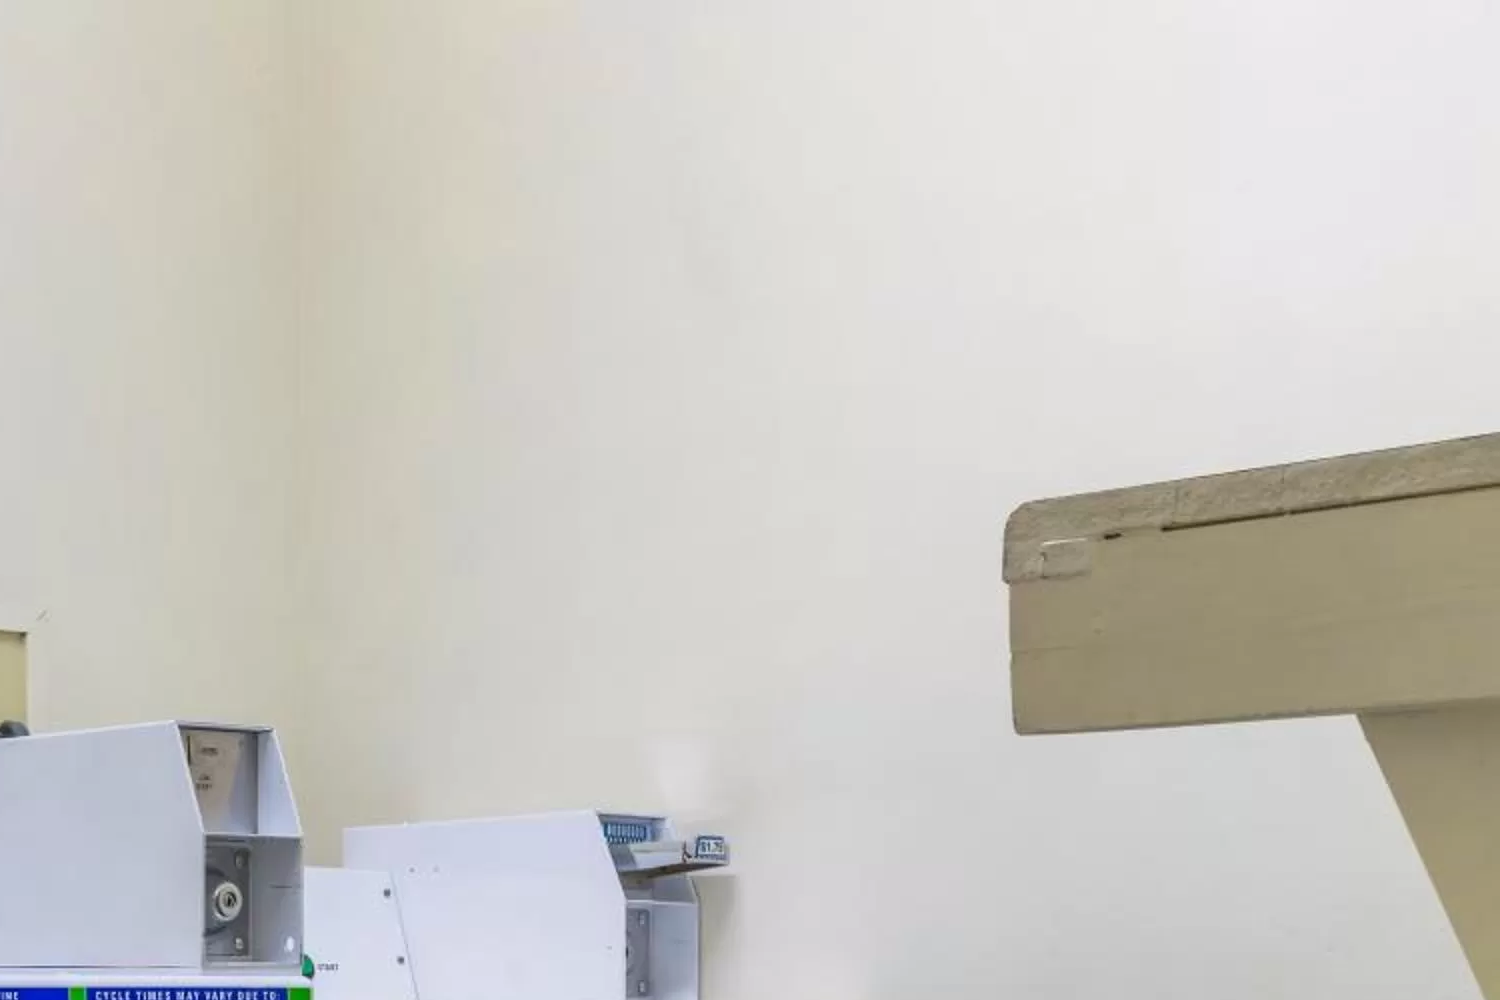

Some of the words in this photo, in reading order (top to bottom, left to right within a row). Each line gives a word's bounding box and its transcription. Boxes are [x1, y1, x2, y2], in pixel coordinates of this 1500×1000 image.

[95, 990, 130, 1000] CYCLE
[135, 990, 171, 1000] TIMES
[175, 991, 200, 1000] MAY
[203, 991, 233, 1000] VARY
[237, 991, 258, 1000] DUE
[263, 991, 281, 1000] TO:
